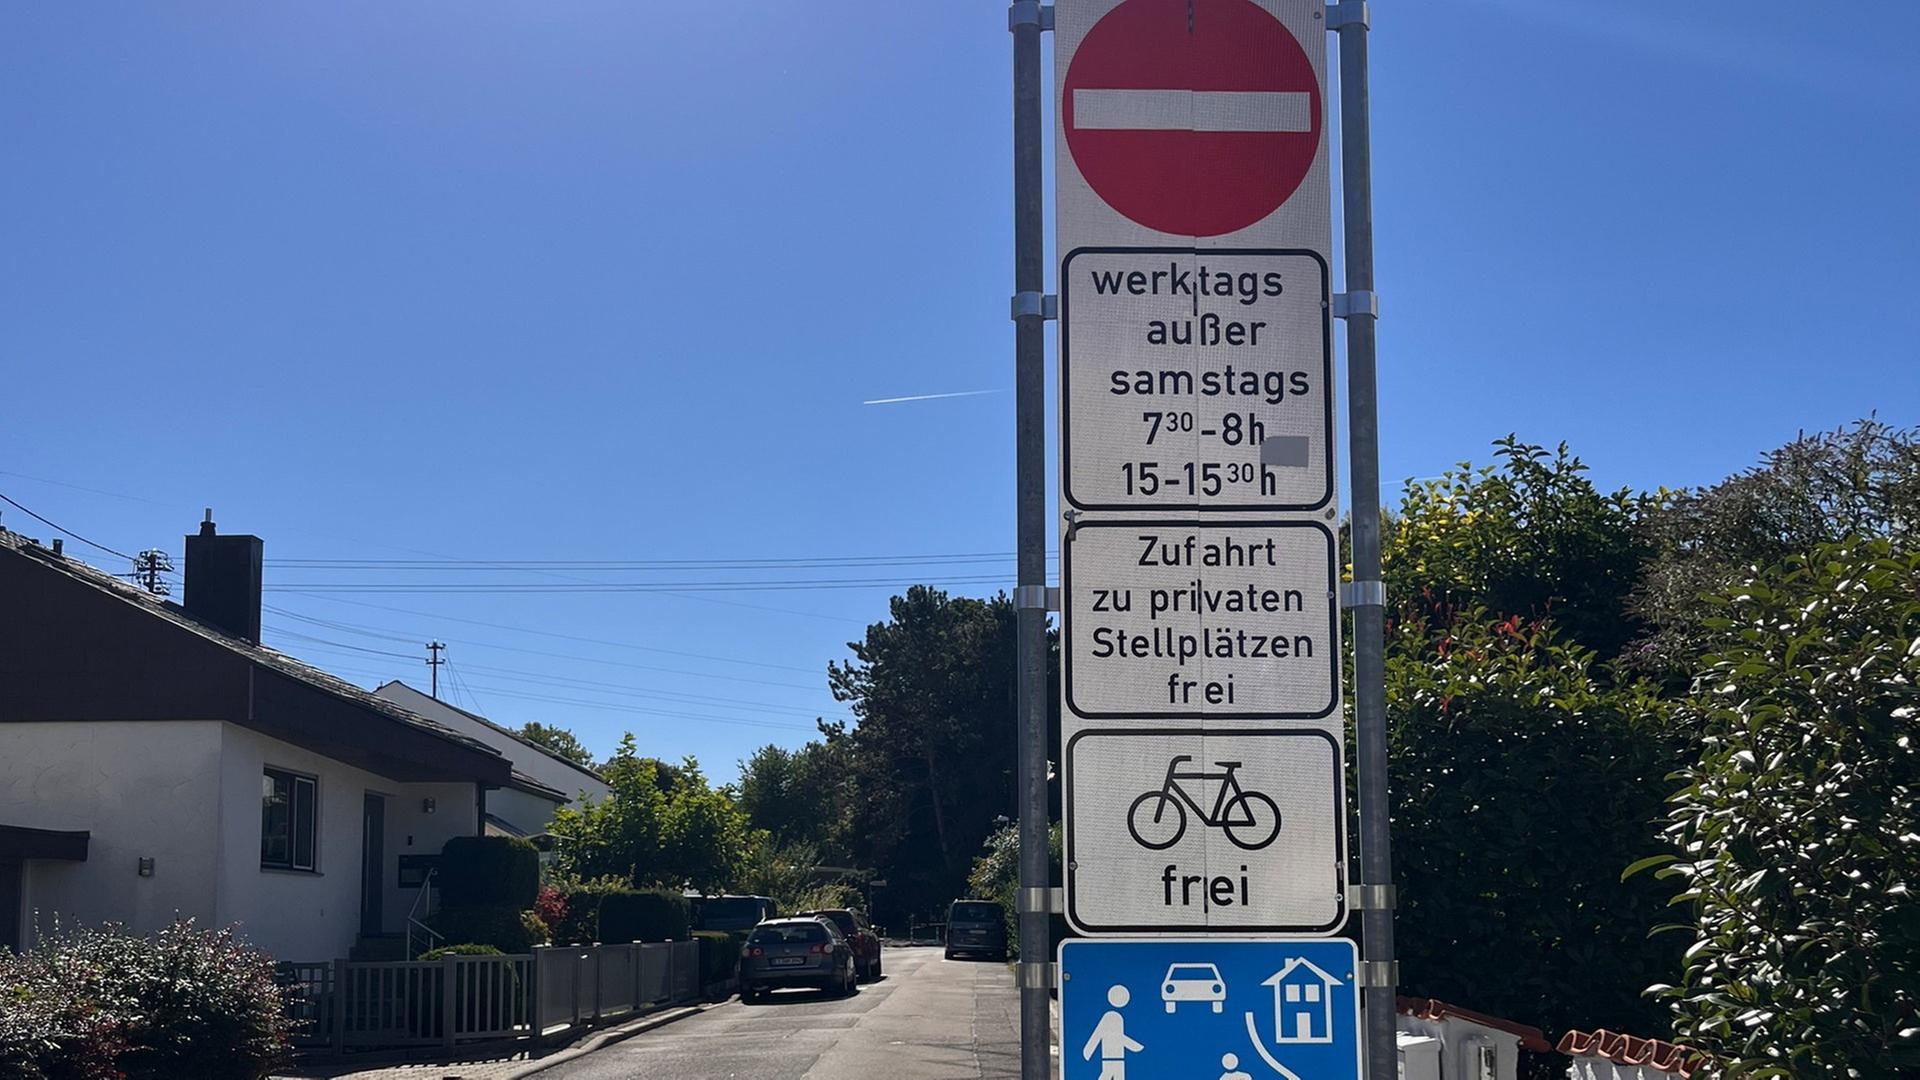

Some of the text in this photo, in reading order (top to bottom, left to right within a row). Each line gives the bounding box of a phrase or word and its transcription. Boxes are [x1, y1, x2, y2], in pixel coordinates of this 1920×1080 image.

[1091, 262, 1283, 305] werktags
[1147, 313, 1267, 346] außer
[1110, 365, 1310, 405] samstags
[1138, 535, 1276, 566] Zufahrt
[1092, 581, 1303, 620] zu privaten
[1092, 627, 1313, 665] Stellplätzen
[1168, 673, 1234, 704] frei
[1162, 865, 1248, 906] frei
